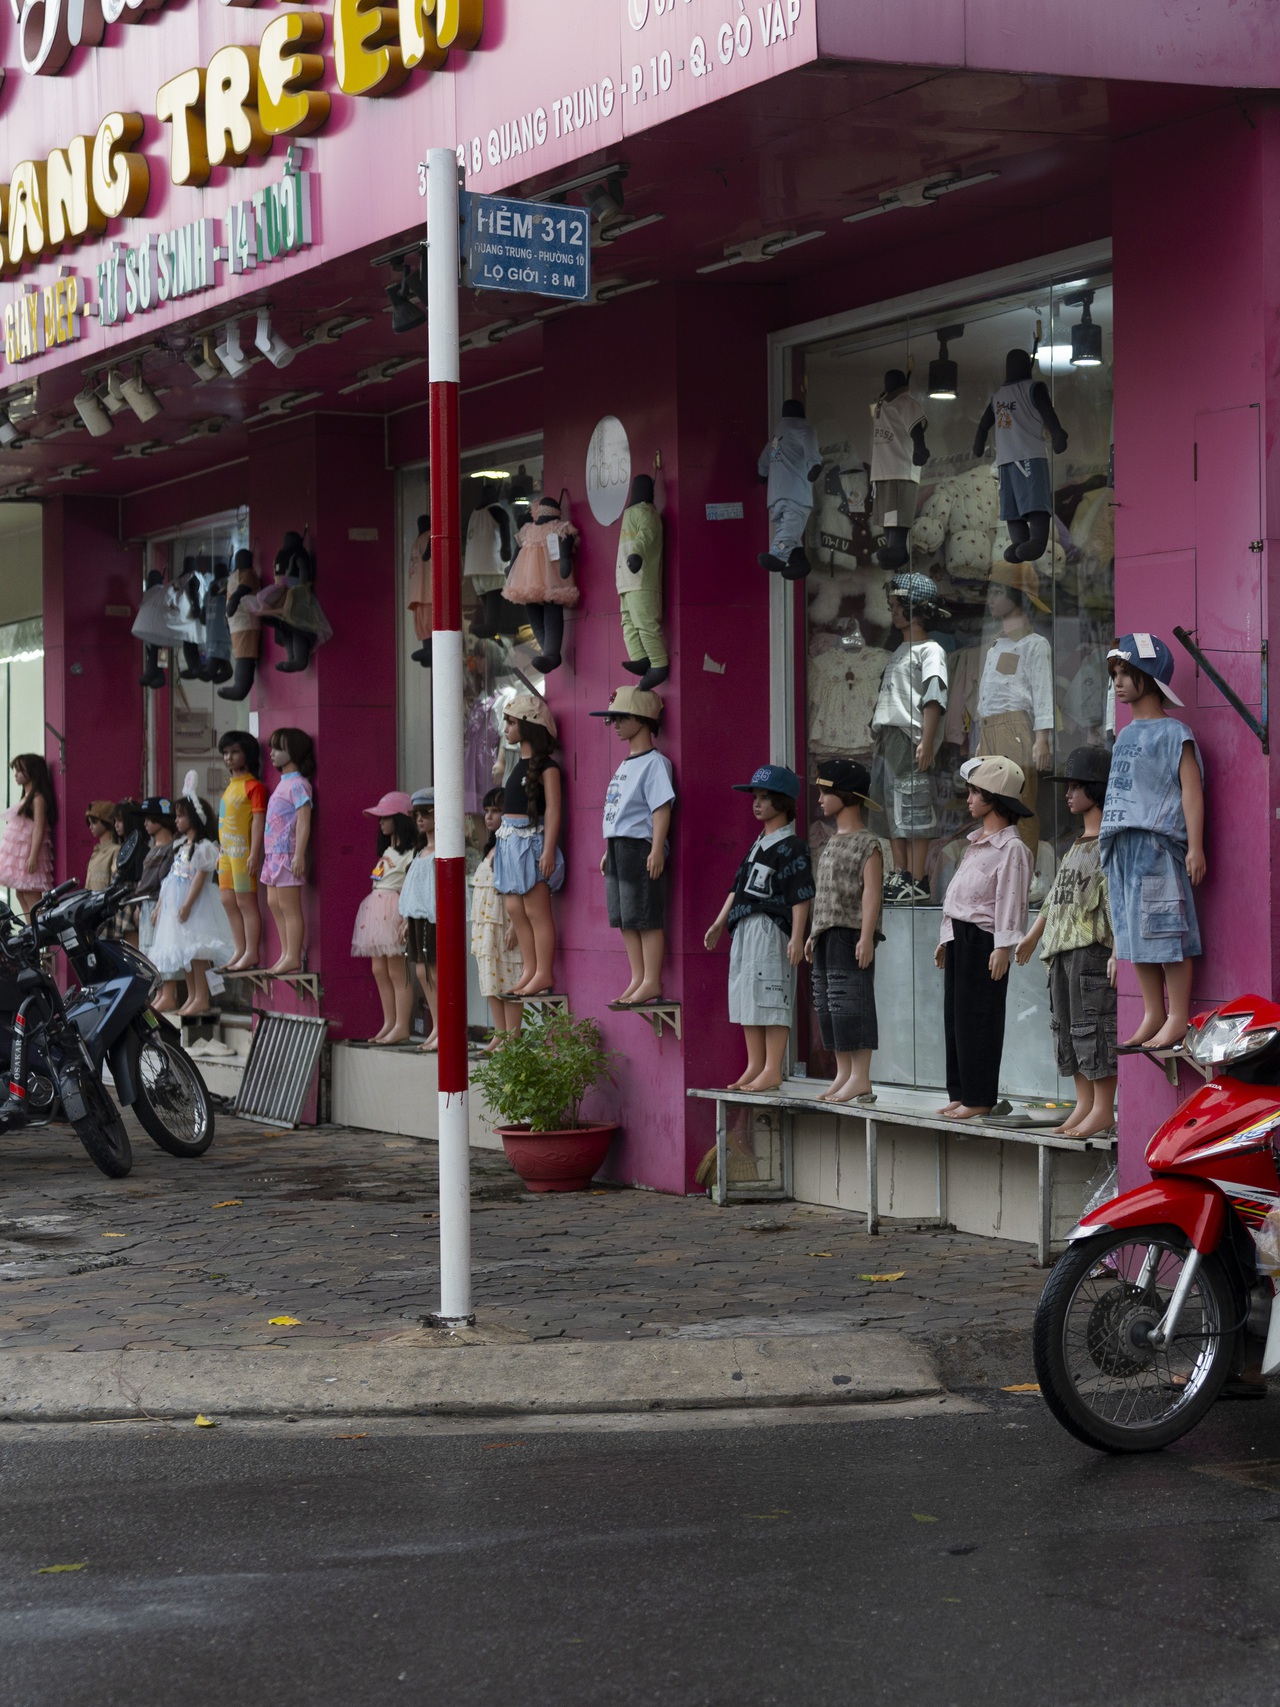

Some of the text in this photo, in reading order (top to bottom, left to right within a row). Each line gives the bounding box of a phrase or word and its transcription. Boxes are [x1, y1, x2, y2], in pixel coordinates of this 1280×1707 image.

[456, 136, 482, 176] 318
[487, 107, 548, 166] QUANG
[552, 77, 614, 138] TRUNG
[0, 112, 140, 272] ANG
[477, 205, 583, 245] HẺM 312
[43, 265, 80, 348] DÉP
[157, 217, 212, 301] SINH
[225, 200, 254, 275] 14
[475, 242, 503, 255] QUANG
[505, 245, 532, 260] TRUNG
[538, 250, 574, 264] PHƯỜNG
[575, 255, 585, 266] 10
[484, 264, 503, 281] LỘ
[508, 265, 539, 283] GIỚI
[551, 274, 560, 286] 8
[564, 275, 575, 288] M
[14, 1039, 23, 1080] OSAKAR
